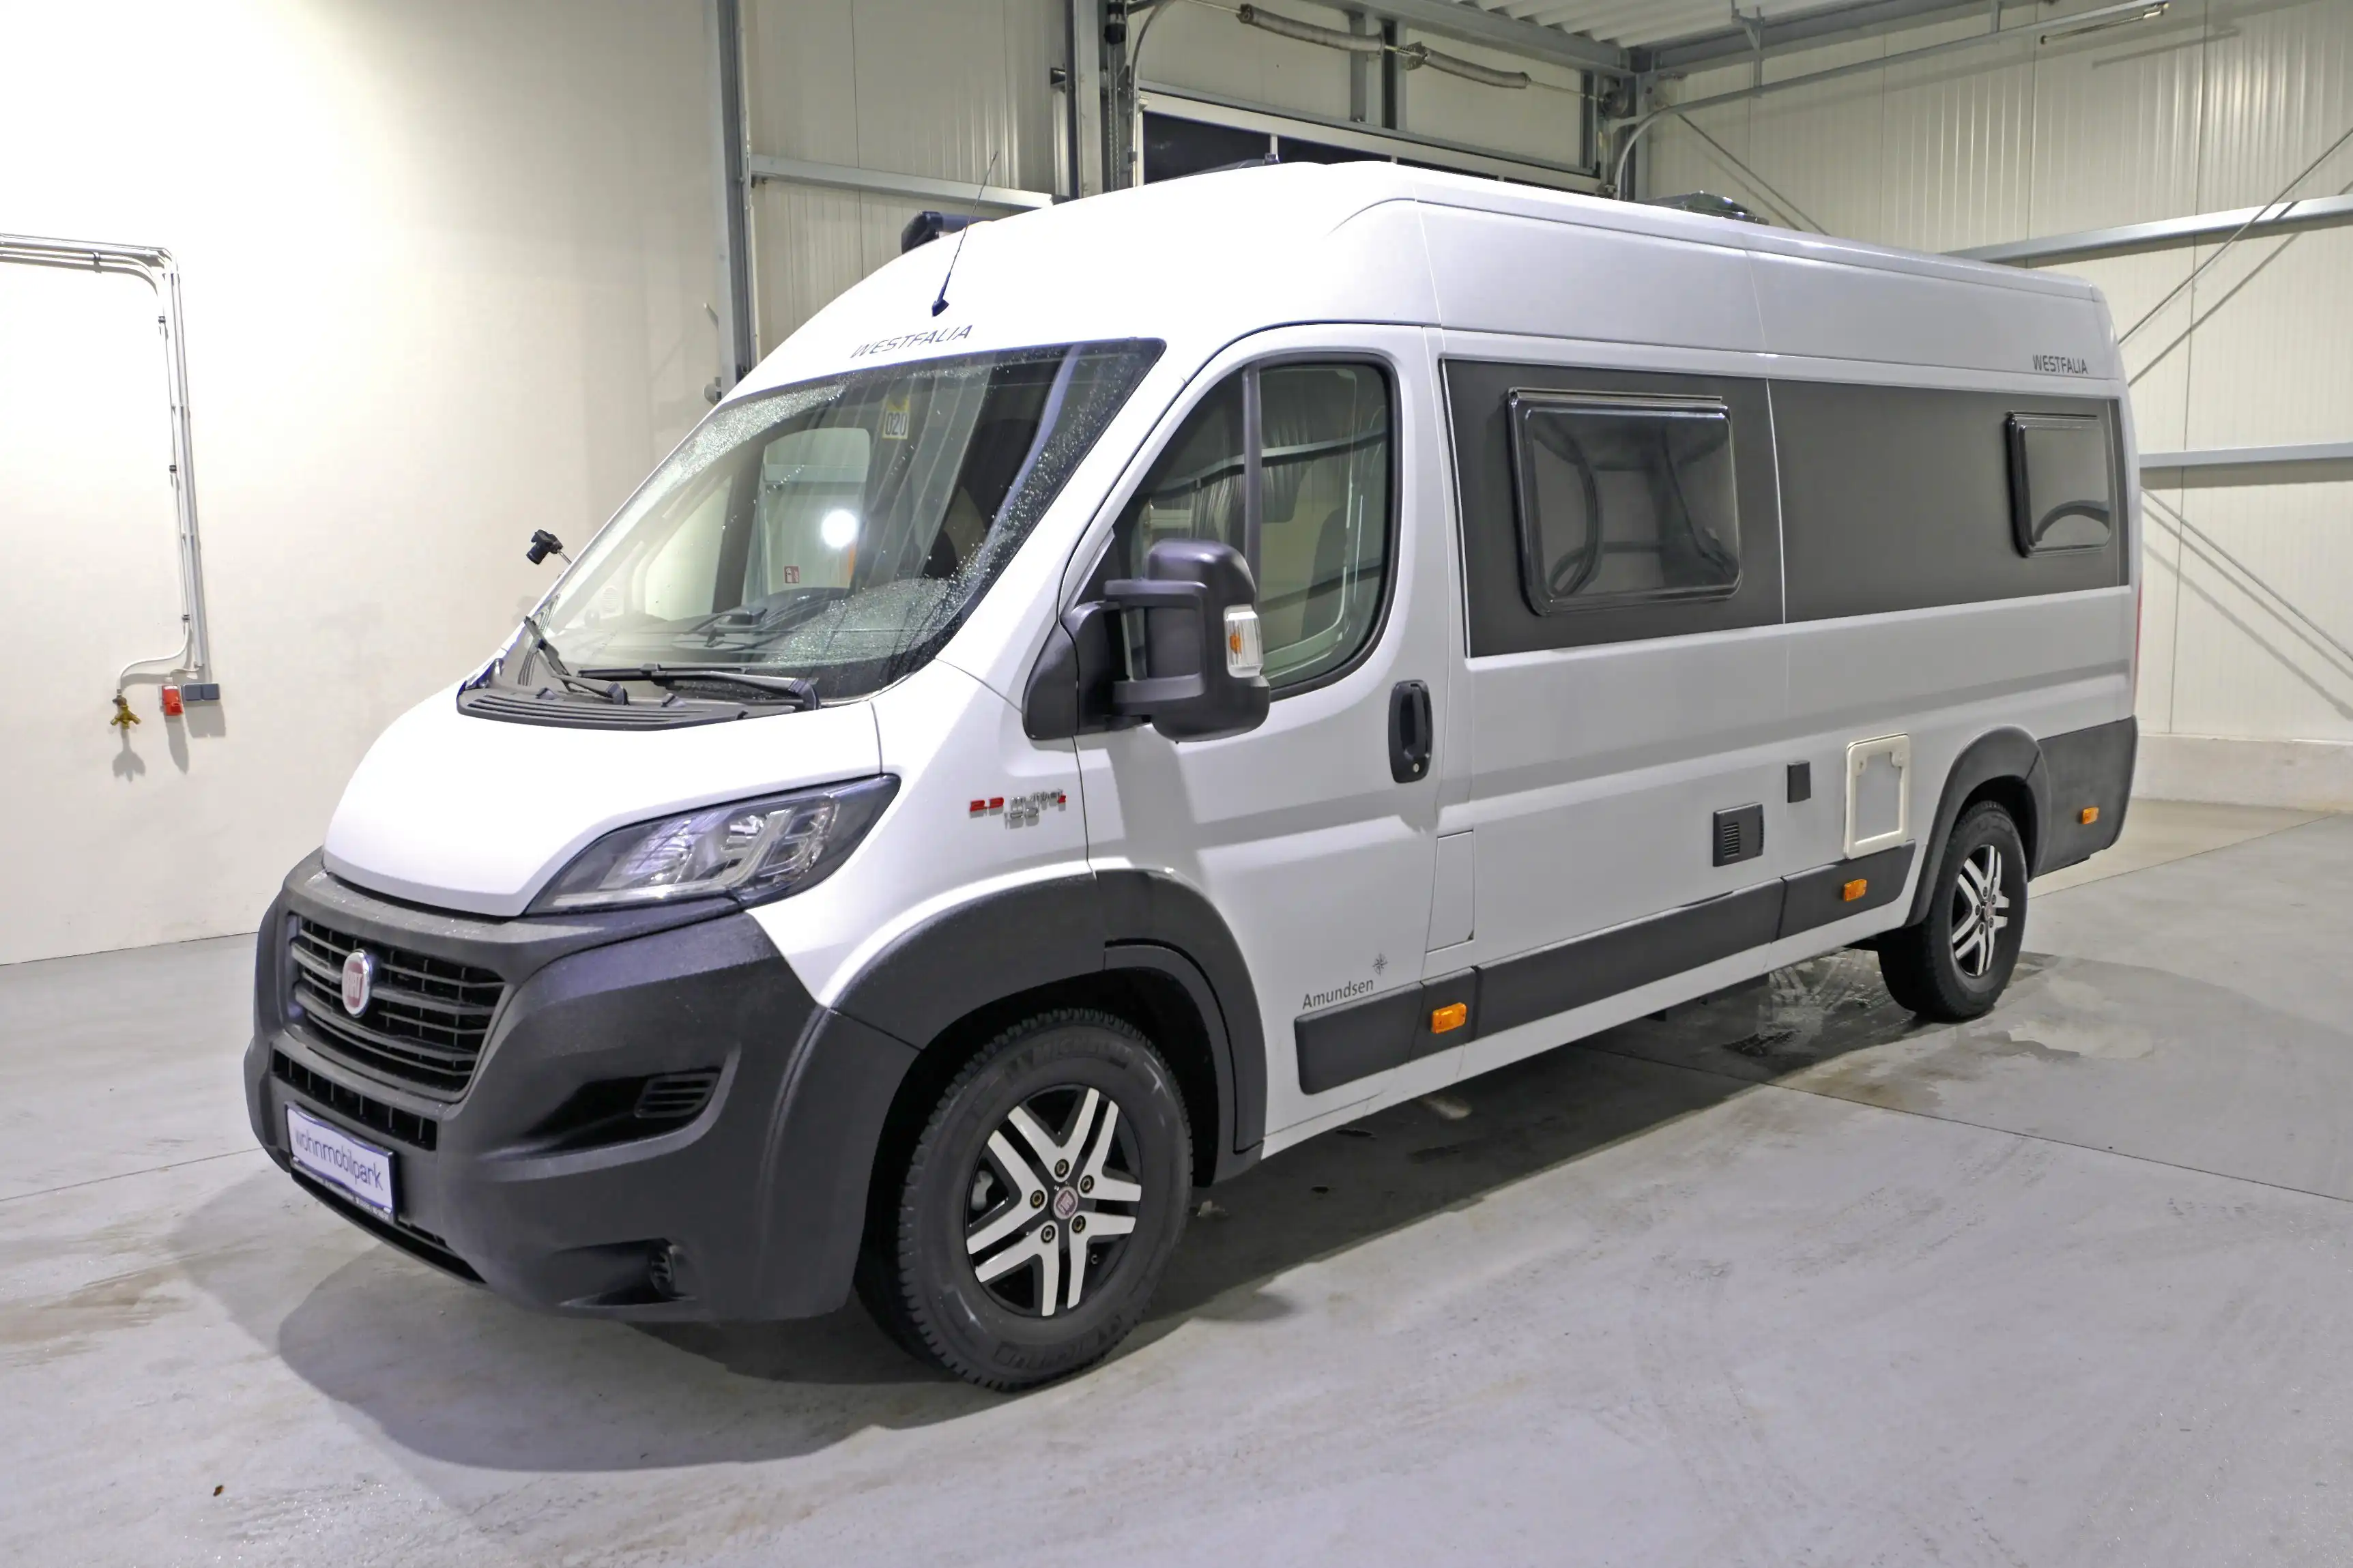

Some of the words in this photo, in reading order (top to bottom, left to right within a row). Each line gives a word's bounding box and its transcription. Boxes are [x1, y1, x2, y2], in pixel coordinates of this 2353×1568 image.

[850, 324, 973, 359] WESTFALIA
[2032, 353, 2089, 375] WESTFALIA
[1302, 979, 1374, 1010] Amundsen
[294, 1128, 384, 1191] wohnmobilpark
